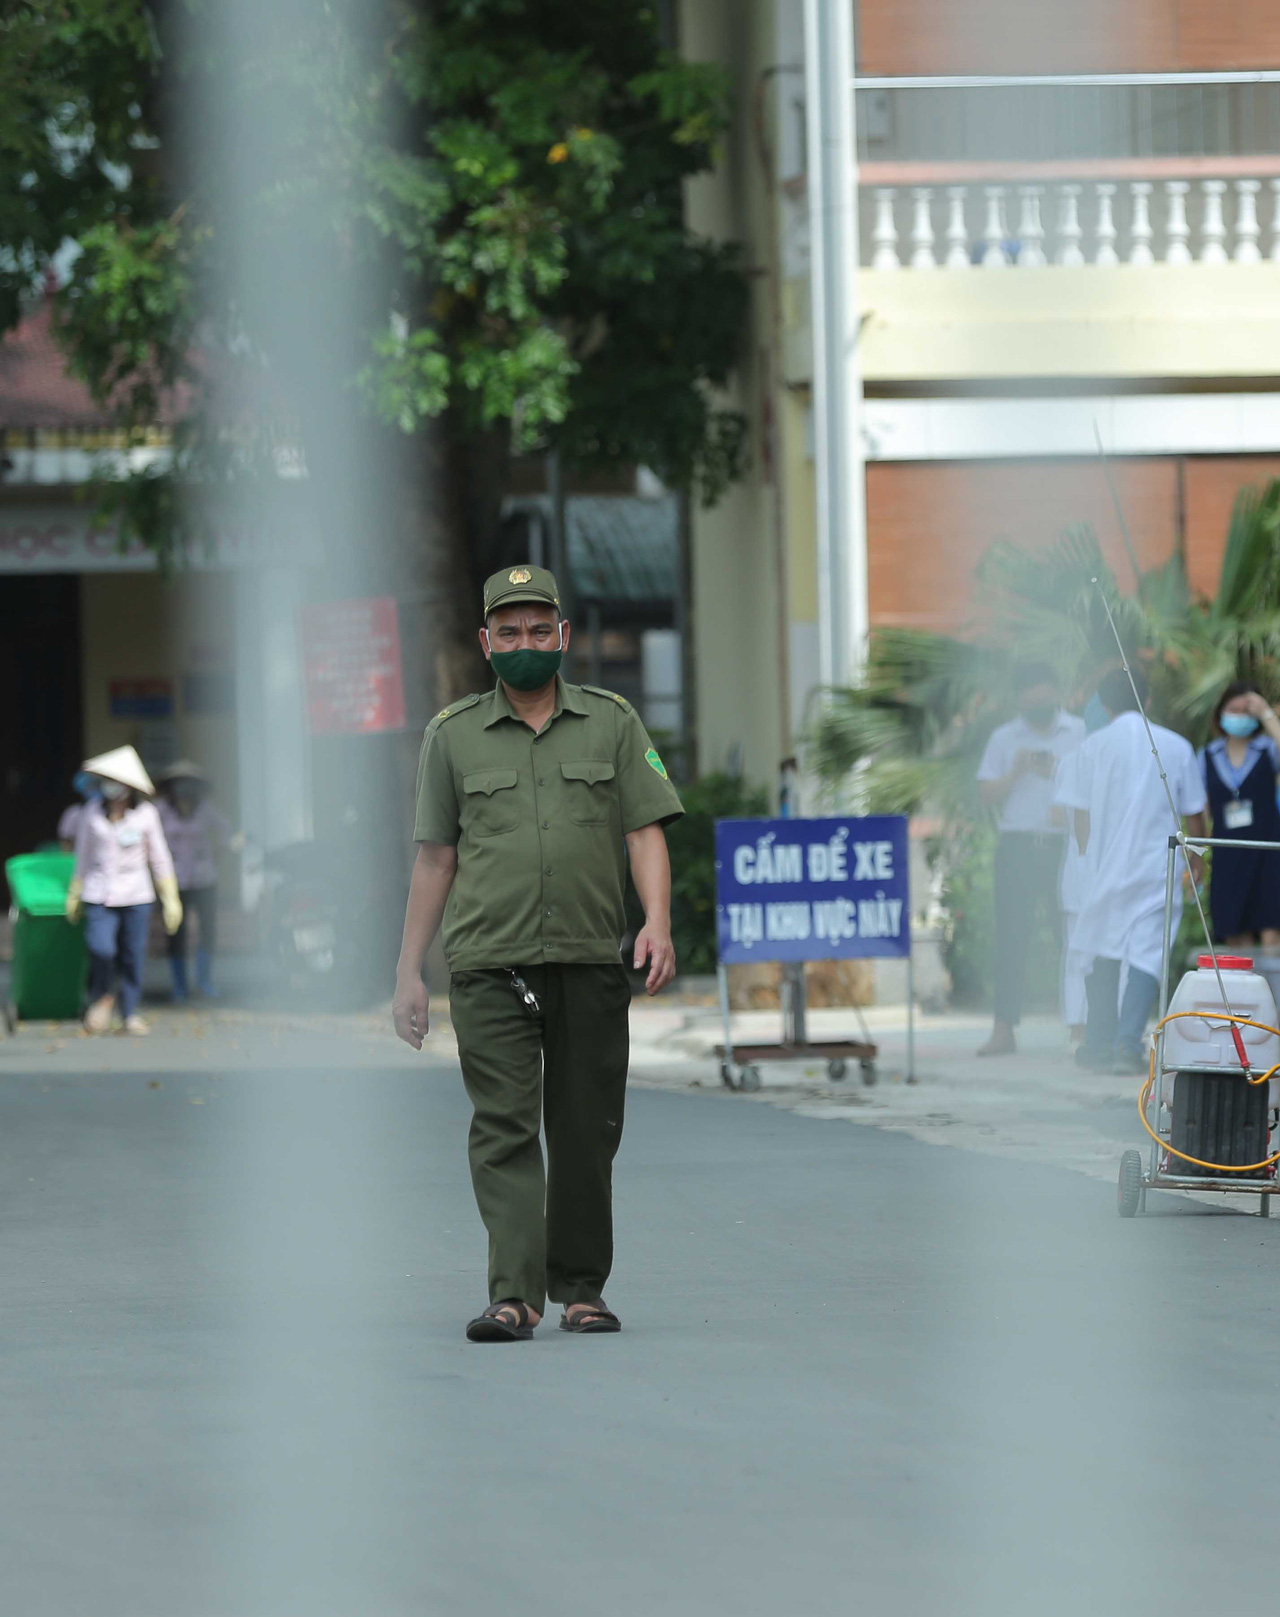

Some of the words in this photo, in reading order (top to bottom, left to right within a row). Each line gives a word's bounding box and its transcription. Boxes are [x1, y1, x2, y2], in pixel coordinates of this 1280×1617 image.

[733, 831, 803, 885] CẤM
[852, 840, 895, 882] XE
[726, 902, 764, 949] TẠI
[765, 901, 811, 941] KHU
[812, 896, 857, 947] VỰC
[858, 890, 903, 939] NÀY
